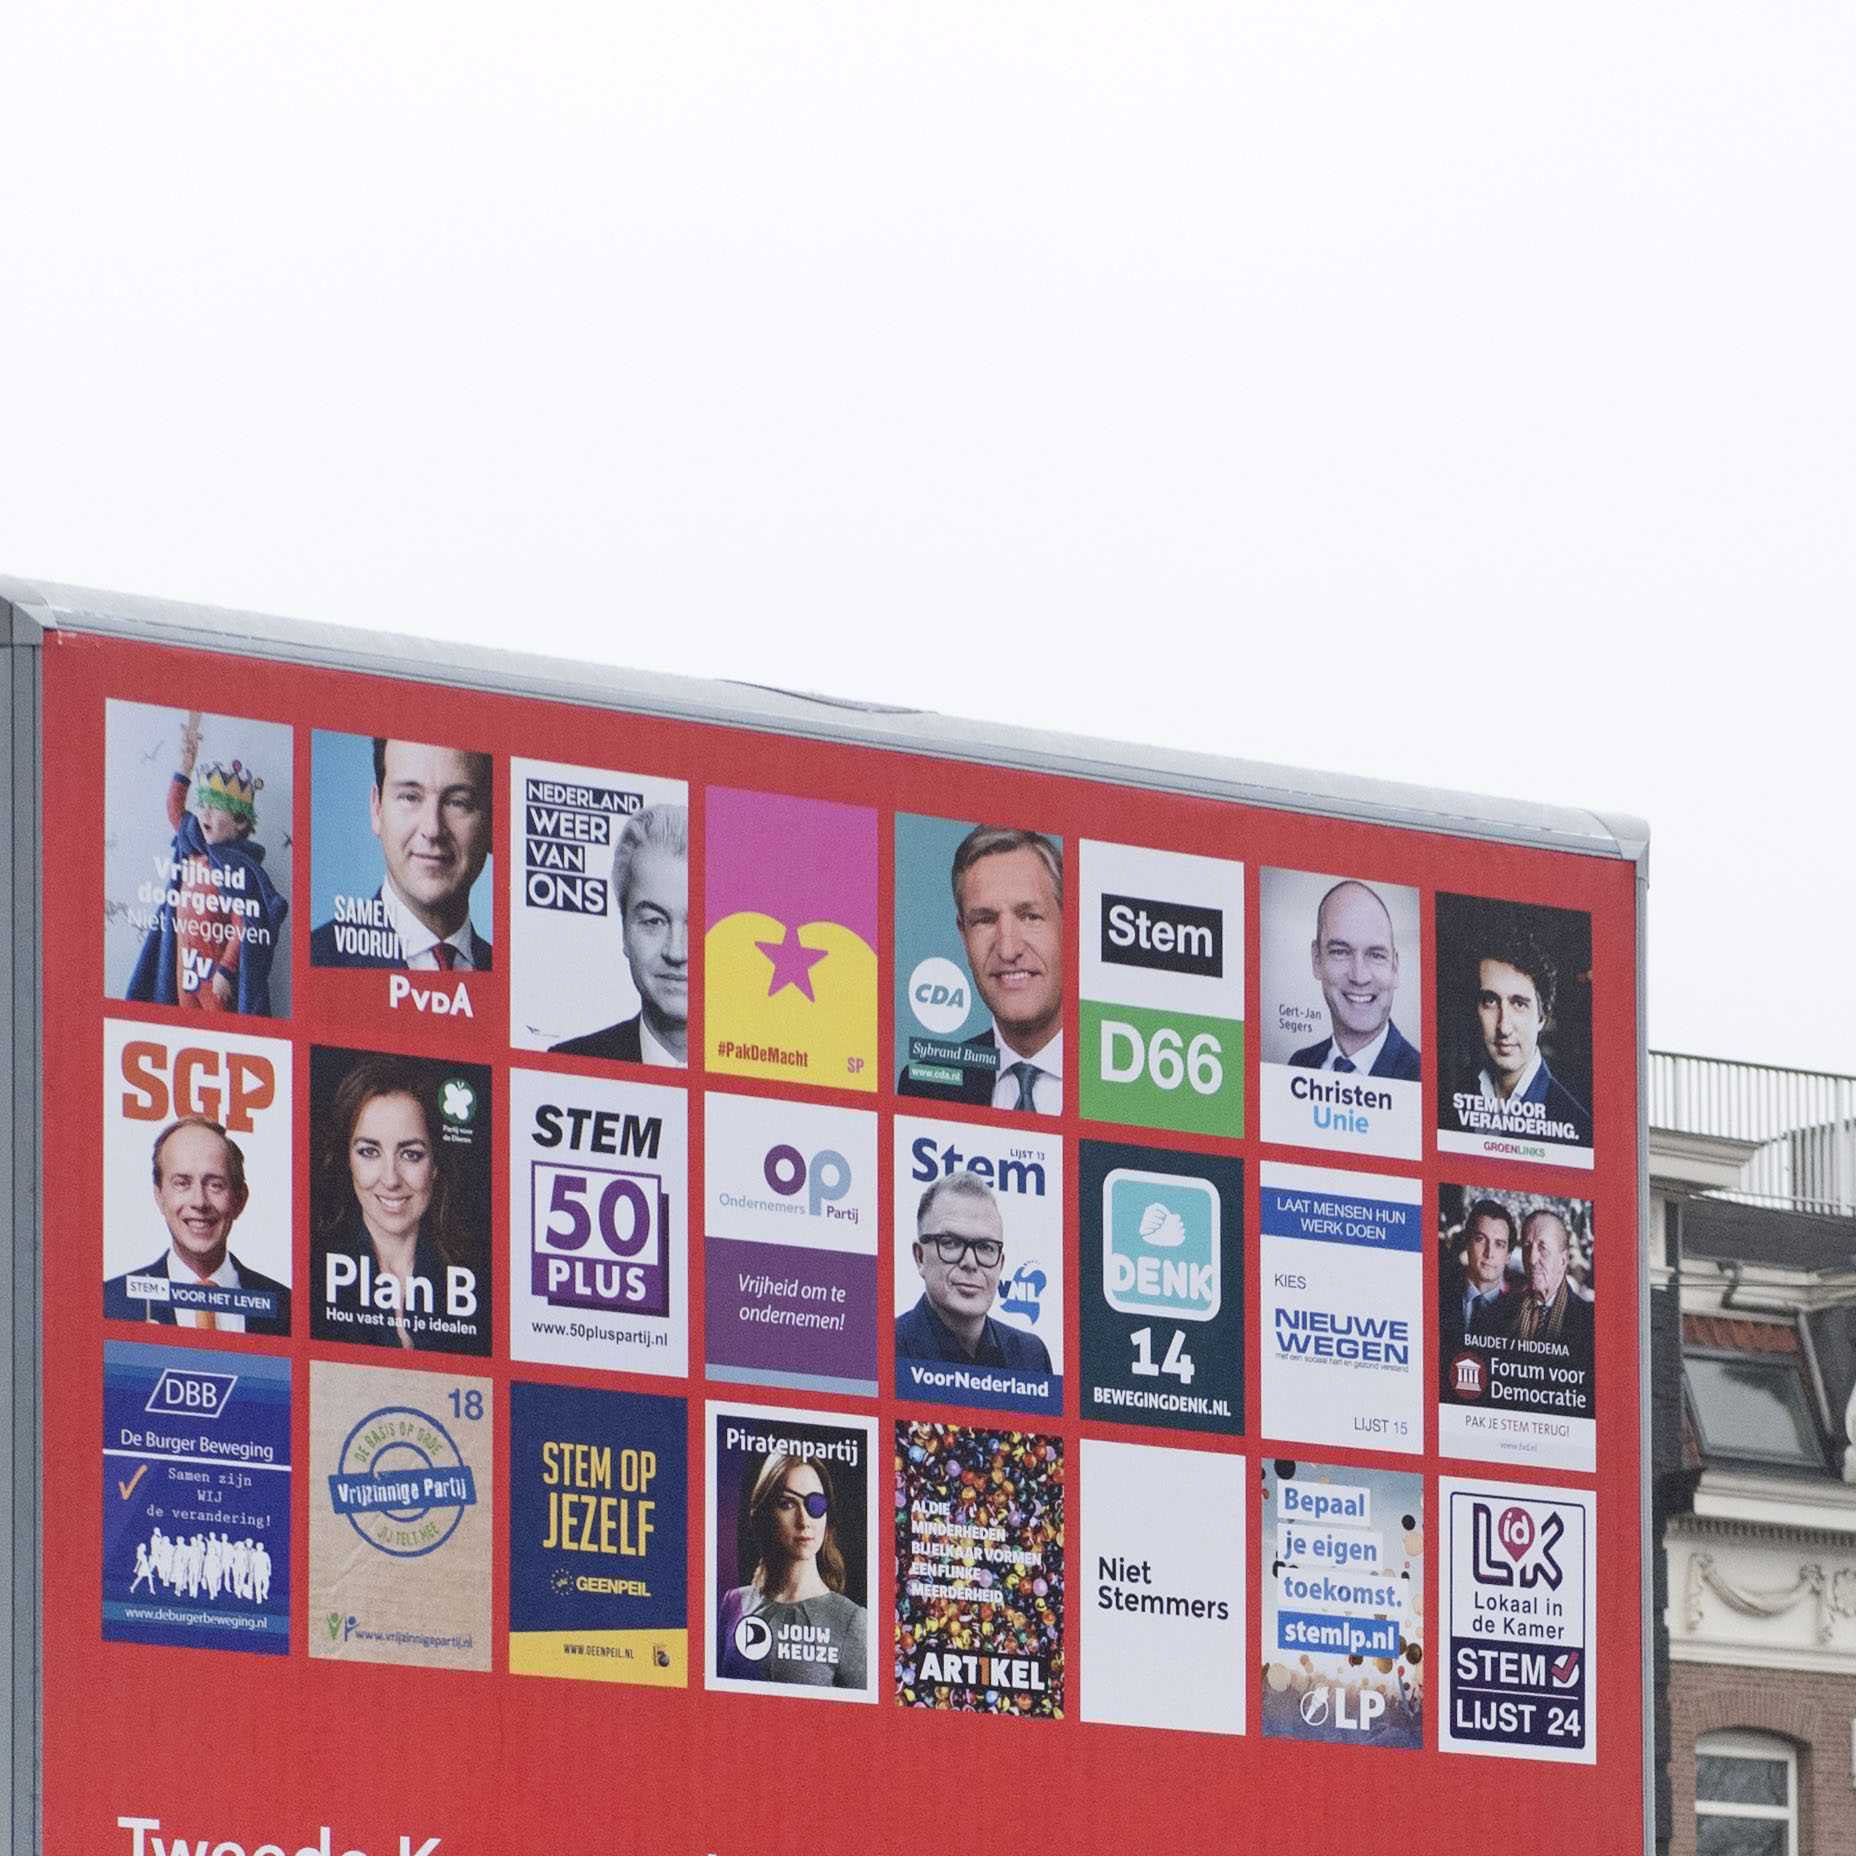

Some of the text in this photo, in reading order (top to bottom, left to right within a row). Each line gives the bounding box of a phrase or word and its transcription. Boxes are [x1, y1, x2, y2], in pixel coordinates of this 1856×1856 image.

[528, 782, 642, 812] NEDERLAND
[529, 808, 608, 843] WEER
[530, 842, 585, 871] VAN
[154, 857, 245, 890] Vrijheid
[137, 885, 260, 919] doorgeven
[528, 874, 606, 912] ONS
[334, 895, 396, 928] SAMEN
[128, 909, 270, 946] Niet weggeven
[1109, 905, 1213, 957] Stem
[334, 926, 409, 961] VOORUIT
[915, 983, 964, 1008] CDA
[1279, 1004, 1322, 1021] Gert-Jan
[1279, 1018, 1312, 1033] Segers
[718, 1040, 808, 1068] #PakDeMacht
[848, 1056, 864, 1073] SP
[913, 1041, 996, 1064] Sybrand Buma
[1101, 1020, 1223, 1095] D66
[121, 1040, 275, 1133] SGP
[912, 1068, 960, 1080] www.cda.nl
[1291, 1076, 1392, 1110] Christen
[1453, 1093, 1546, 1117] STEM VOOR
[532, 1104, 662, 1159] STEM
[1313, 1107, 1369, 1133] Unie
[1458, 1109, 1580, 1140] VERANDERING.
[1010, 1149, 1033, 1161] LIJST
[1484, 1141, 1545, 1158] GROENLINKS
[912, 1137, 1045, 1197] Stem
[545, 1174, 650, 1257] 50
[719, 1192, 859, 1224] Ondernemers Partij
[1277, 1197, 1406, 1225] LAAT MENSEN HUN
[1300, 1218, 1386, 1240] WERK DOEN
[325, 1252, 477, 1317] Plan B
[548, 1258, 646, 1301] PLUS
[738, 1273, 846, 1302] Vrijheid om te
[1111, 1253, 1214, 1301] DENK
[1274, 1274, 1306, 1290] KIES
[129, 1279, 270, 1311] STEM VOOR HET LEVEN
[326, 1307, 477, 1336] Hou vast aan je idealen
[739, 1305, 845, 1331] ondernemen!
[1275, 1308, 1408, 1341] NIEUWE
[532, 1321, 668, 1347] www.50pluspartij.nl
[1276, 1332, 1408, 1365] WEGEN
[1464, 1333, 1569, 1357] BAUDET HIDDEMA
[1130, 1327, 1195, 1384] 14
[911, 1367, 1048, 1397] VoorNederland
[1491, 1358, 1585, 1385] Forum voor
[165, 1379, 218, 1409] DBB
[448, 1388, 484, 1421] 18
[1094, 1387, 1231, 1417] BEWEGINGDENK.NL
[1491, 1381, 1587, 1409] Democratie
[1354, 1416, 1408, 1436] LIJST 15
[1465, 1415, 1570, 1437] PAK JE STEM TERUG!
[120, 1429, 274, 1461] De Burger Beweging
[726, 1427, 859, 1467] Piratenpartij
[168, 1468, 252, 1487] Samen zijn
[542, 1442, 656, 1494] STEM OP
[198, 1489, 222, 1503] WIJ
[337, 1477, 467, 1506] Vrijzinnige Partij
[1284, 1487, 1365, 1517] Bepaal
[147, 1504, 271, 1529] de verandering!
[543, 1492, 656, 1557] JEZELF
[984, 1548, 1042, 1566] VORMEN
[1285, 1531, 1377, 1565] je eigen
[1098, 1556, 1152, 1585] Niet
[576, 1576, 651, 1597] GEENPEIL
[912, 1583, 1004, 1602] MEERDERHEID
[1285, 1576, 1403, 1607] toekomst.
[1098, 1585, 1229, 1620] Stemmers
[1475, 1592, 1563, 1616] Lokaal in
[125, 1606, 267, 1631] www.deburgerbeweging.nl
[777, 1623, 831, 1643] JOUW
[1472, 1615, 1565, 1640] de Kamer
[564, 1644, 634, 1659] WWW.GEENPEIL.NL
[777, 1639, 839, 1664] KEUZE
[1285, 1622, 1394, 1652] stemlp.nl
[919, 1651, 1045, 1690] ART1KEL
[1457, 1648, 1545, 1686] STEM
[1335, 1689, 1386, 1731] LP
[1456, 1699, 1581, 1737] LIJST 24
